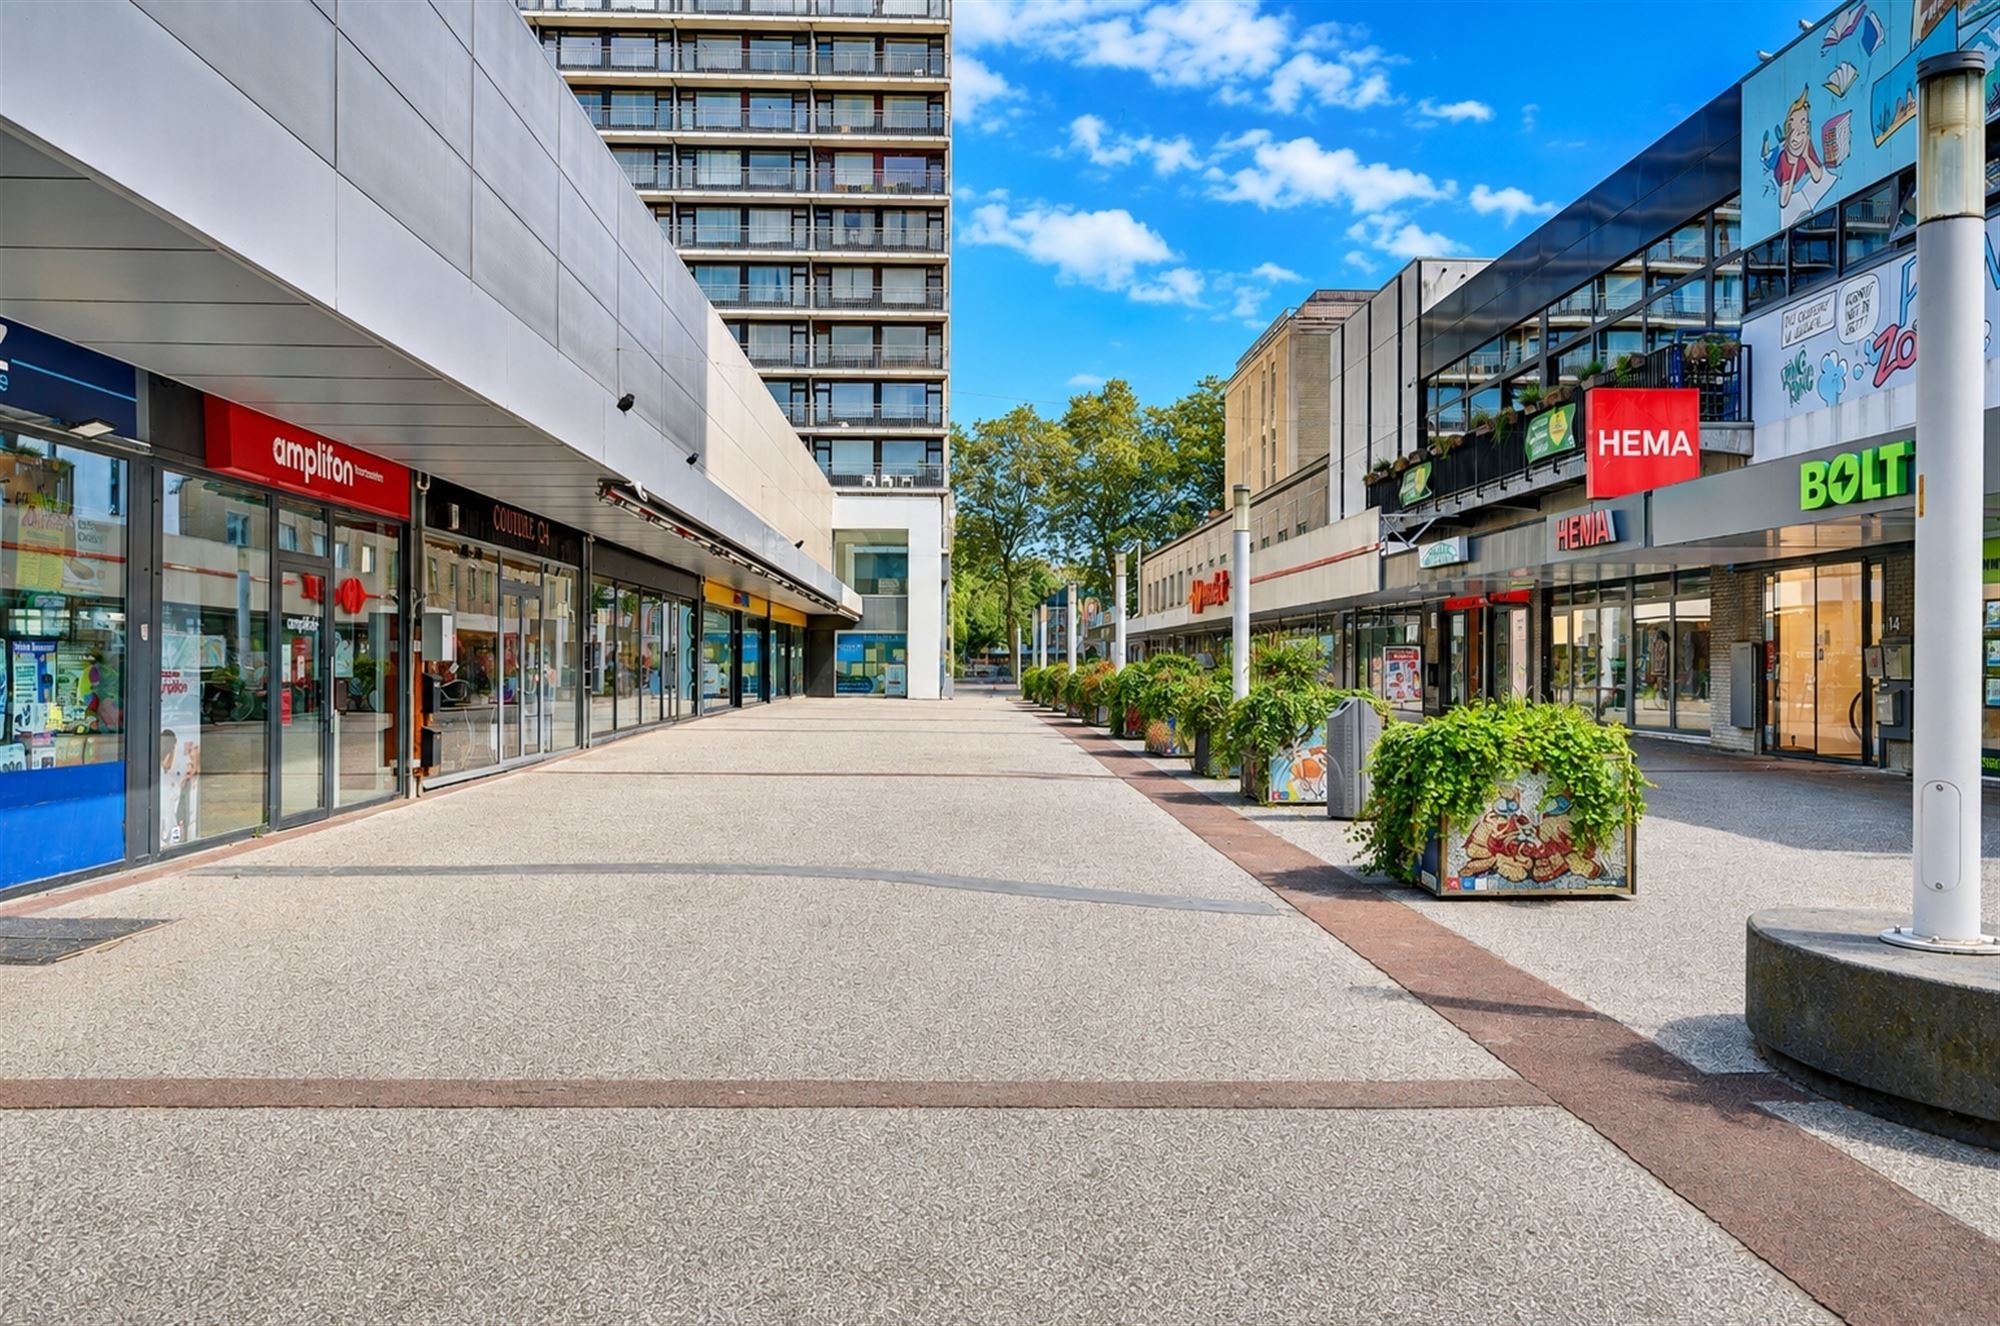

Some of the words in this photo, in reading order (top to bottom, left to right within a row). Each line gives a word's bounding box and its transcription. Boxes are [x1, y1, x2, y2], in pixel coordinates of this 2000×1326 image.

[272, 436, 354, 487] amplifon
[1599, 430, 1693, 456] HEMA
[1800, 440, 1913, 511] BOLT
[1555, 509, 1616, 550] HEMA
